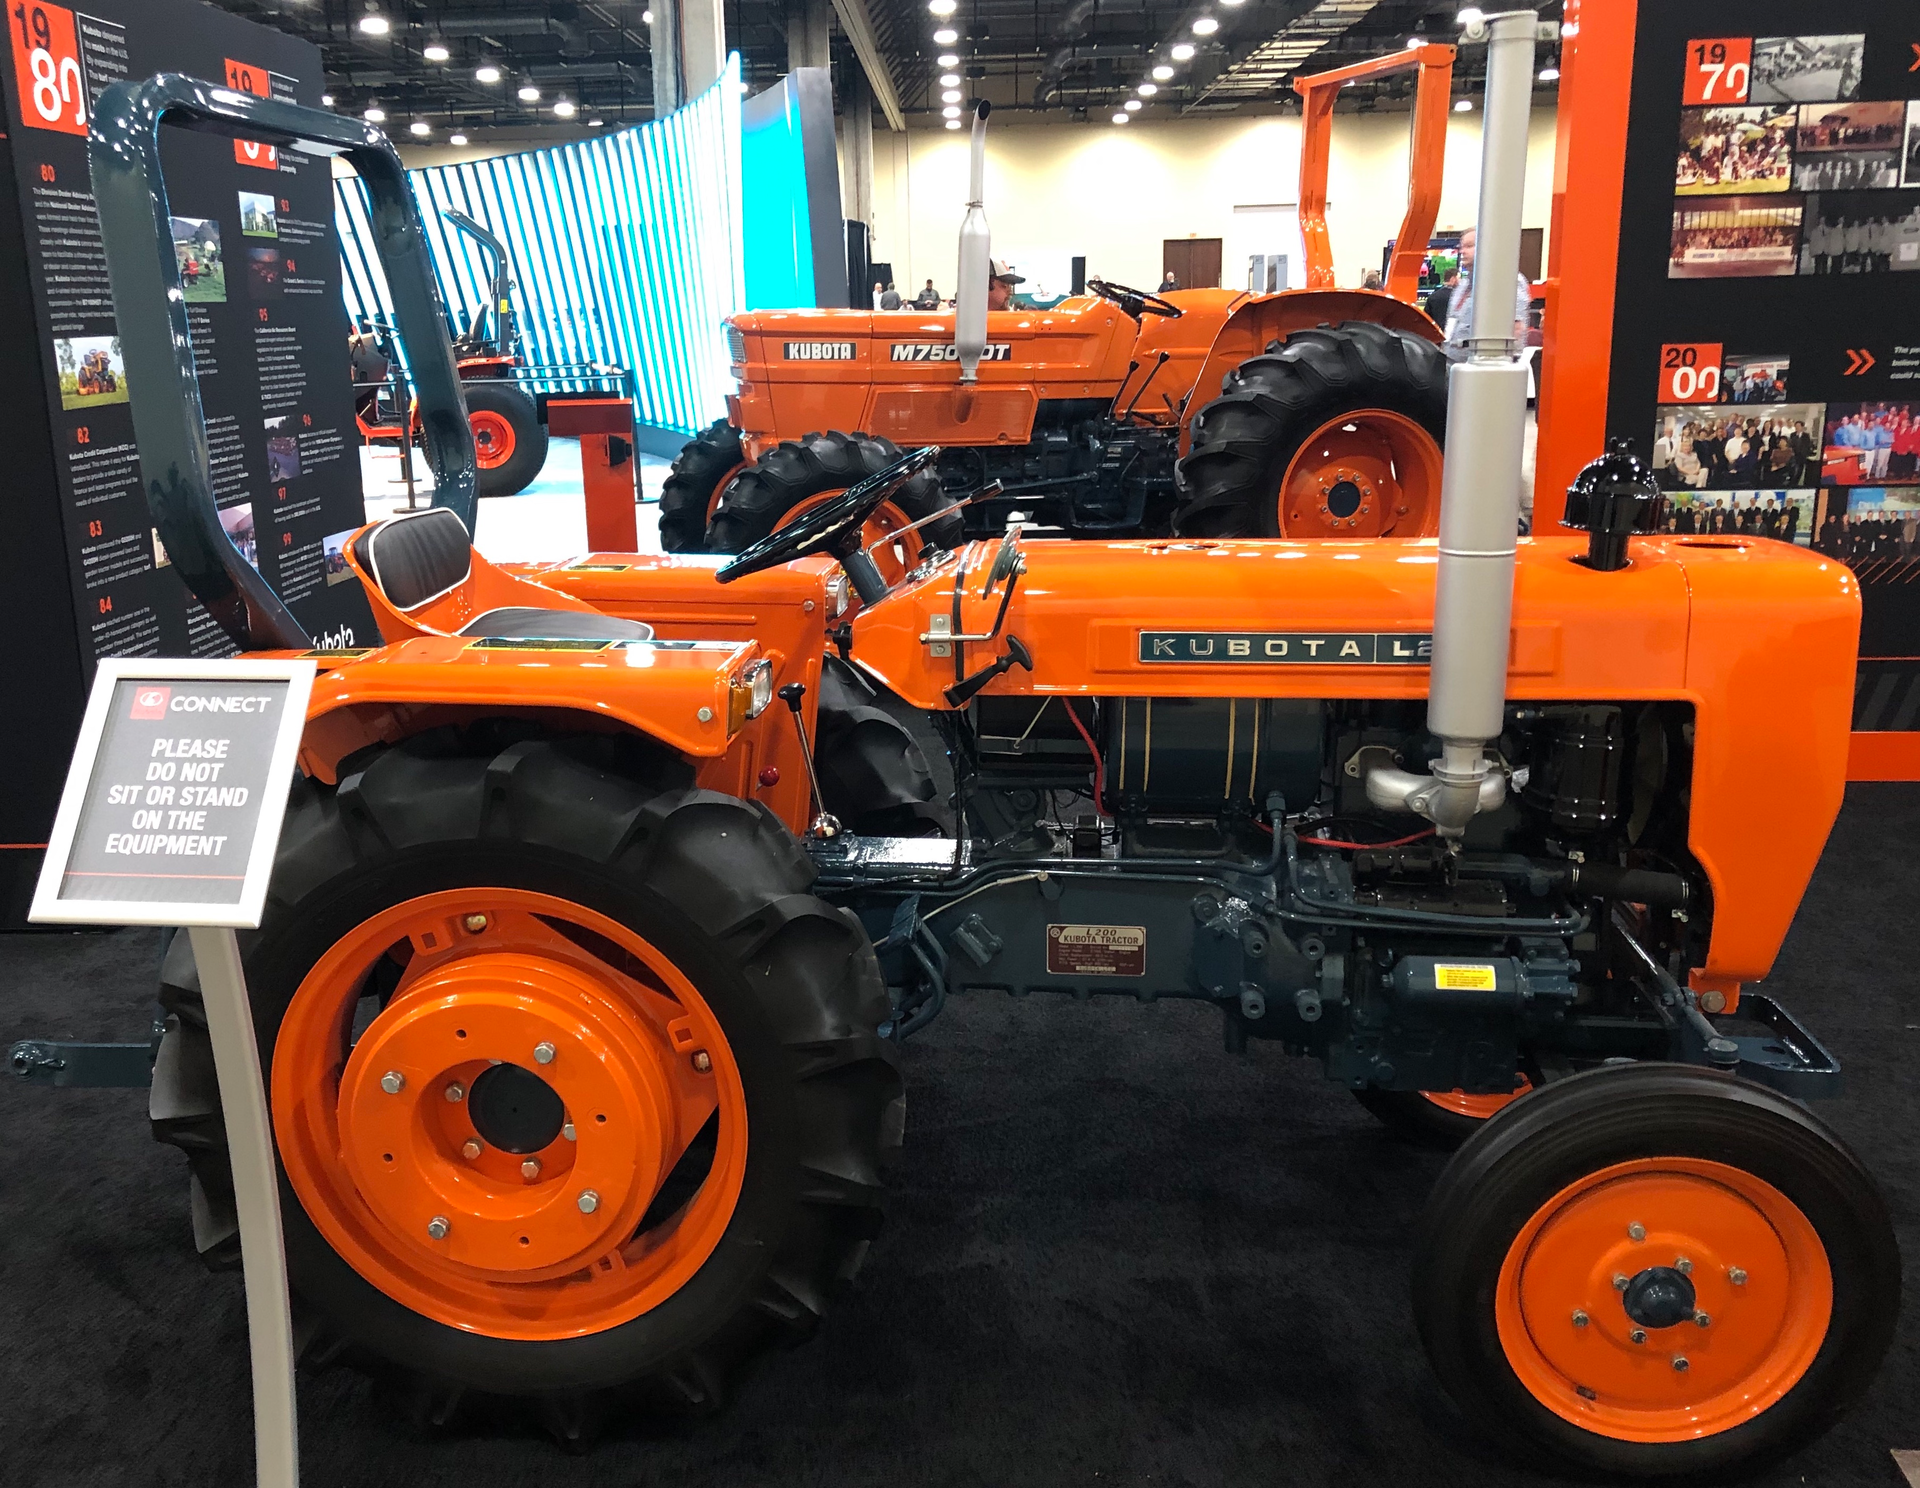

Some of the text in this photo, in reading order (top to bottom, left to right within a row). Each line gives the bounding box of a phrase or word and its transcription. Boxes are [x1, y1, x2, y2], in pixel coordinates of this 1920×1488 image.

[14, 3, 51, 51] 19
[1694, 43, 1727, 65] 19
[31, 47, 87, 126] 80
[1700, 63, 1750, 100] 70
[41, 163, 56, 183] 80
[789, 343, 851, 359] KUBOTA
[1664, 347, 1697, 368] 20
[1672, 366, 1720, 399] 00
[77, 426, 90, 444] 82
[89, 520, 103, 538] 83
[99, 595, 113, 614] 84
[312, 624, 354, 650] bota
[1153, 638, 1433, 657] KUBOTA L2
[170, 696, 271, 713] CONNECT
[151, 738, 230, 759] PLEASE
[146, 761, 224, 782] DO NOT
[107, 785, 249, 807] SIT OR STAND
[132, 809, 207, 831] ON THE
[104, 833, 227, 856] EQUIPMENT
[1063, 935, 1139, 944] KUBOTA TRACTOR
